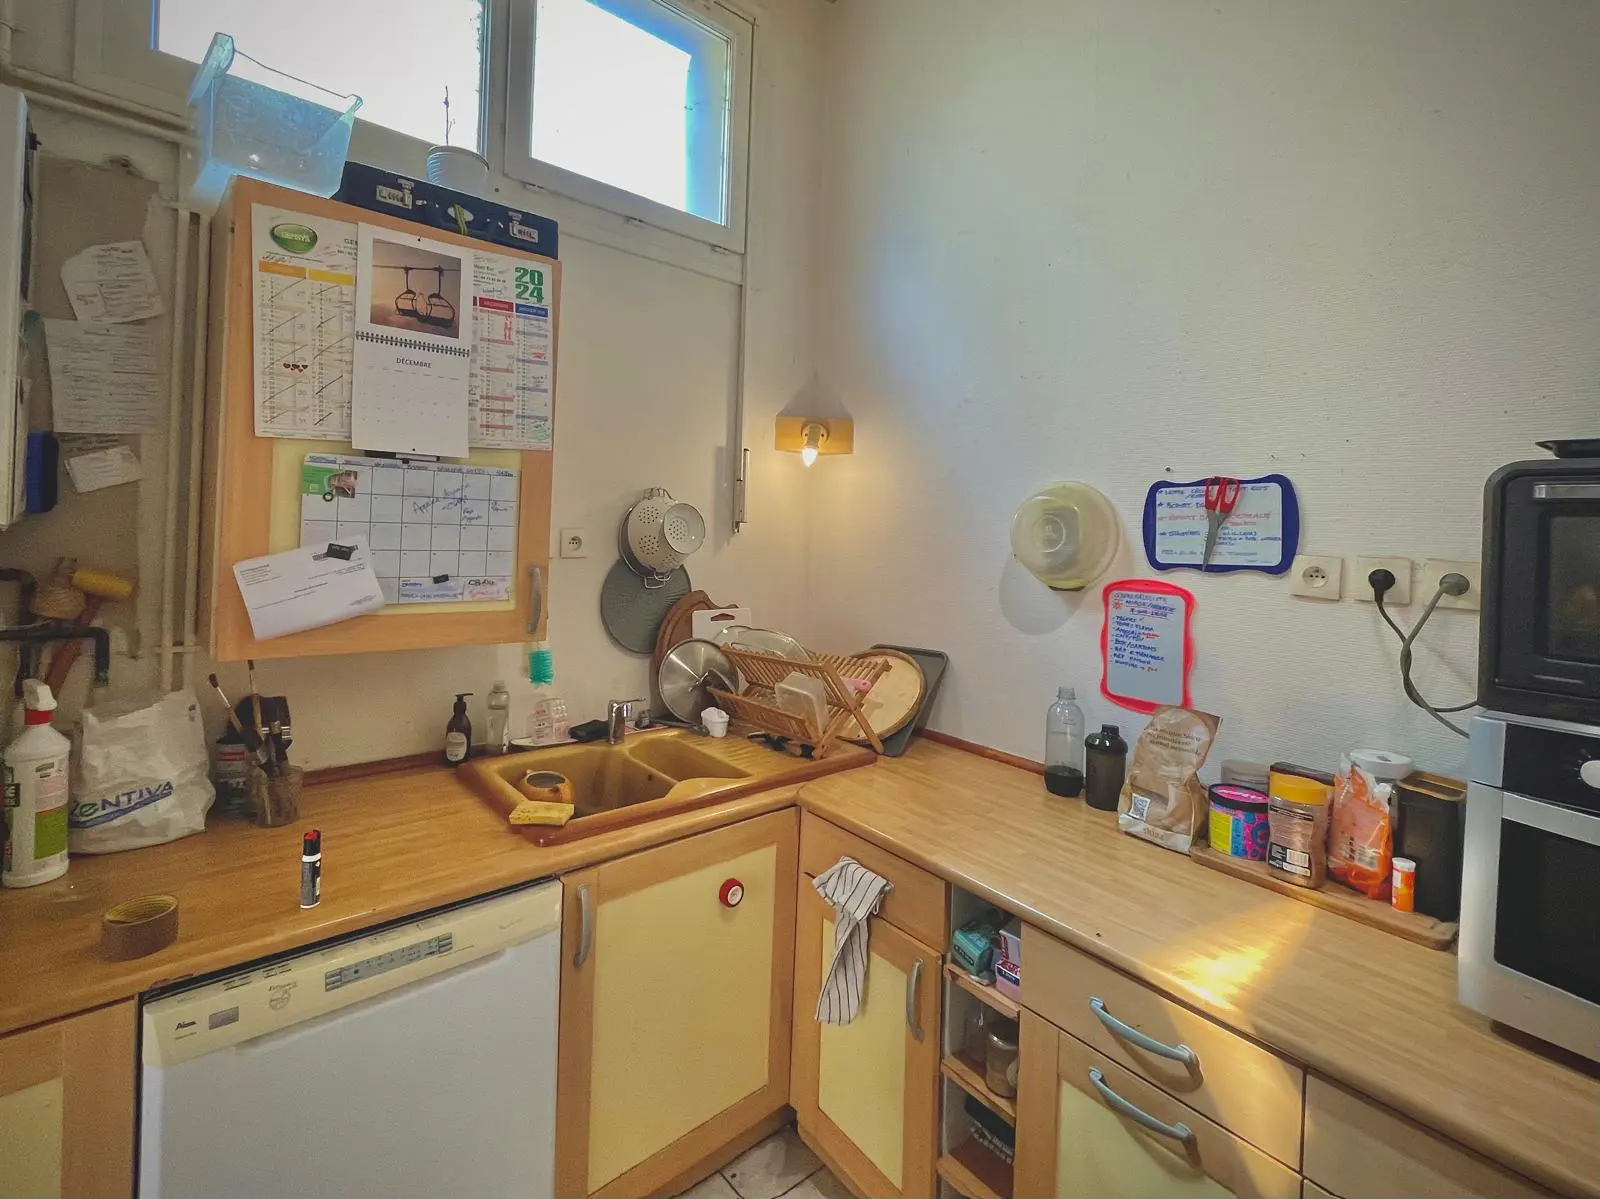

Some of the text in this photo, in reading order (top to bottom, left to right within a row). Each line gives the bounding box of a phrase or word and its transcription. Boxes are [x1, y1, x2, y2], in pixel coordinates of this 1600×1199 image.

[515, 266, 544, 286] 20
[515, 283, 544, 304] 24
[396, 357, 432, 369] DÉCEMBRE
